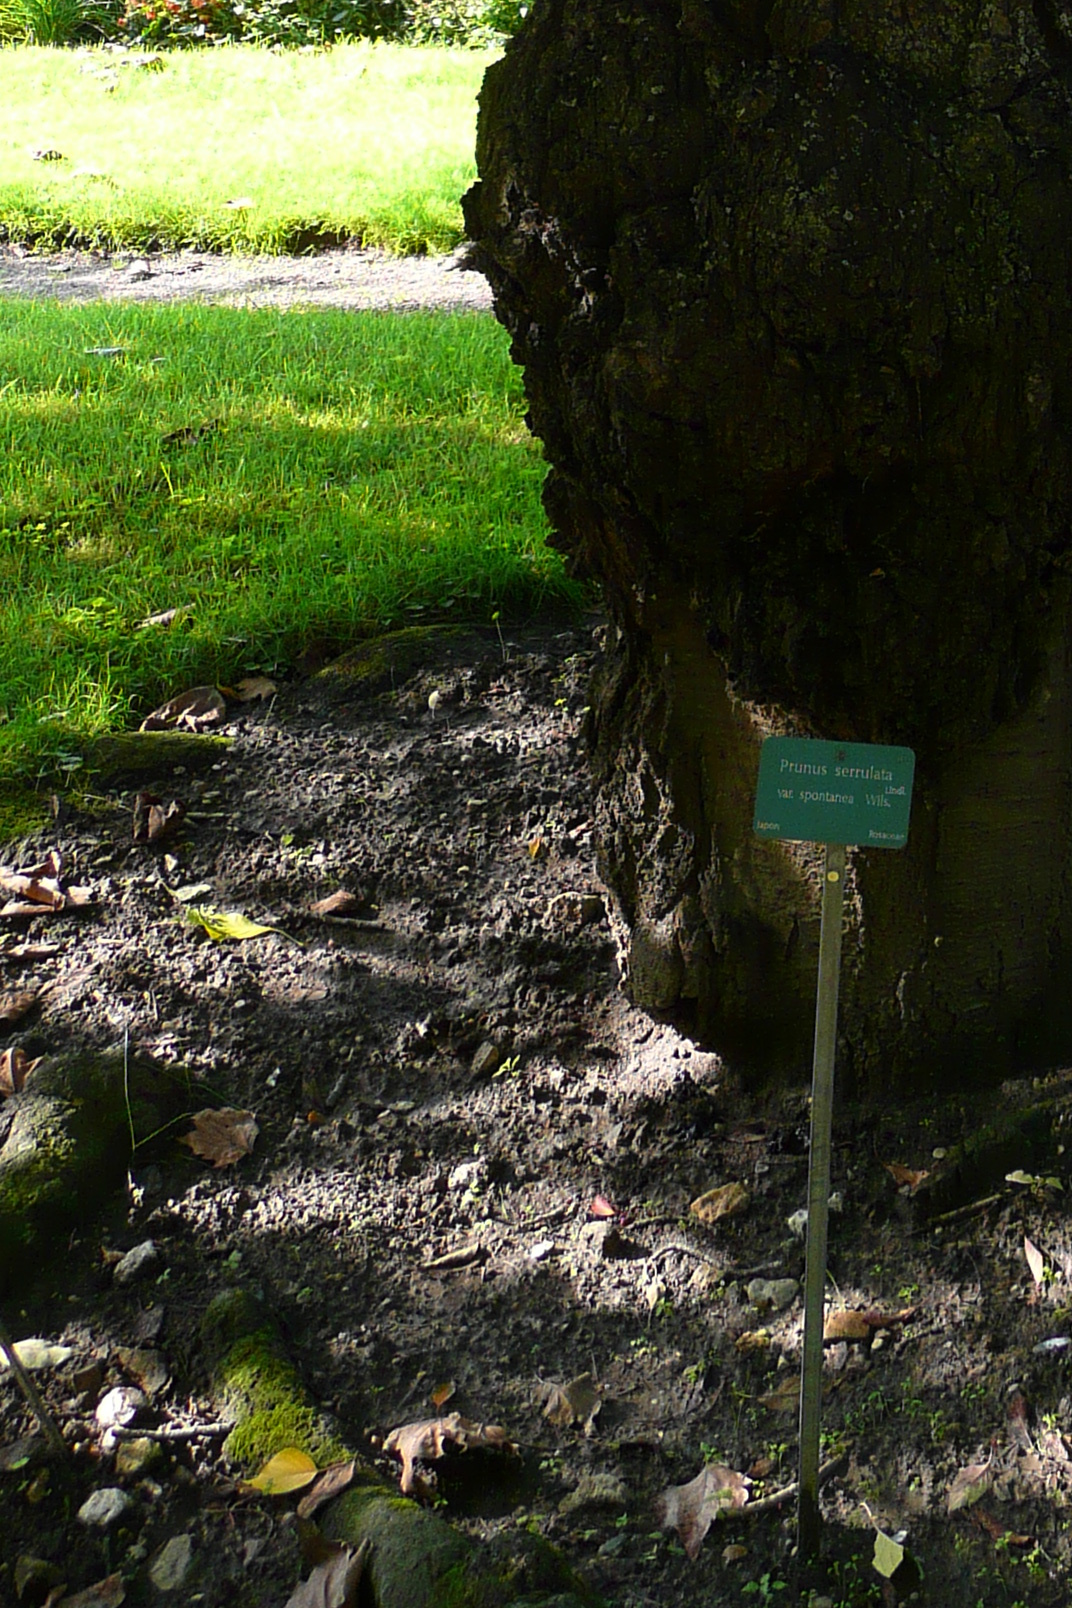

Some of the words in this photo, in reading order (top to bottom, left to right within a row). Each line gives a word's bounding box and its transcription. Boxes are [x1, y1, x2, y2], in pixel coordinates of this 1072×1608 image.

[780, 758, 828, 776] Prunus
[834, 765, 893, 781] serrulata
[777, 788, 794, 799] var.
[799, 790, 854, 804] spontanea
